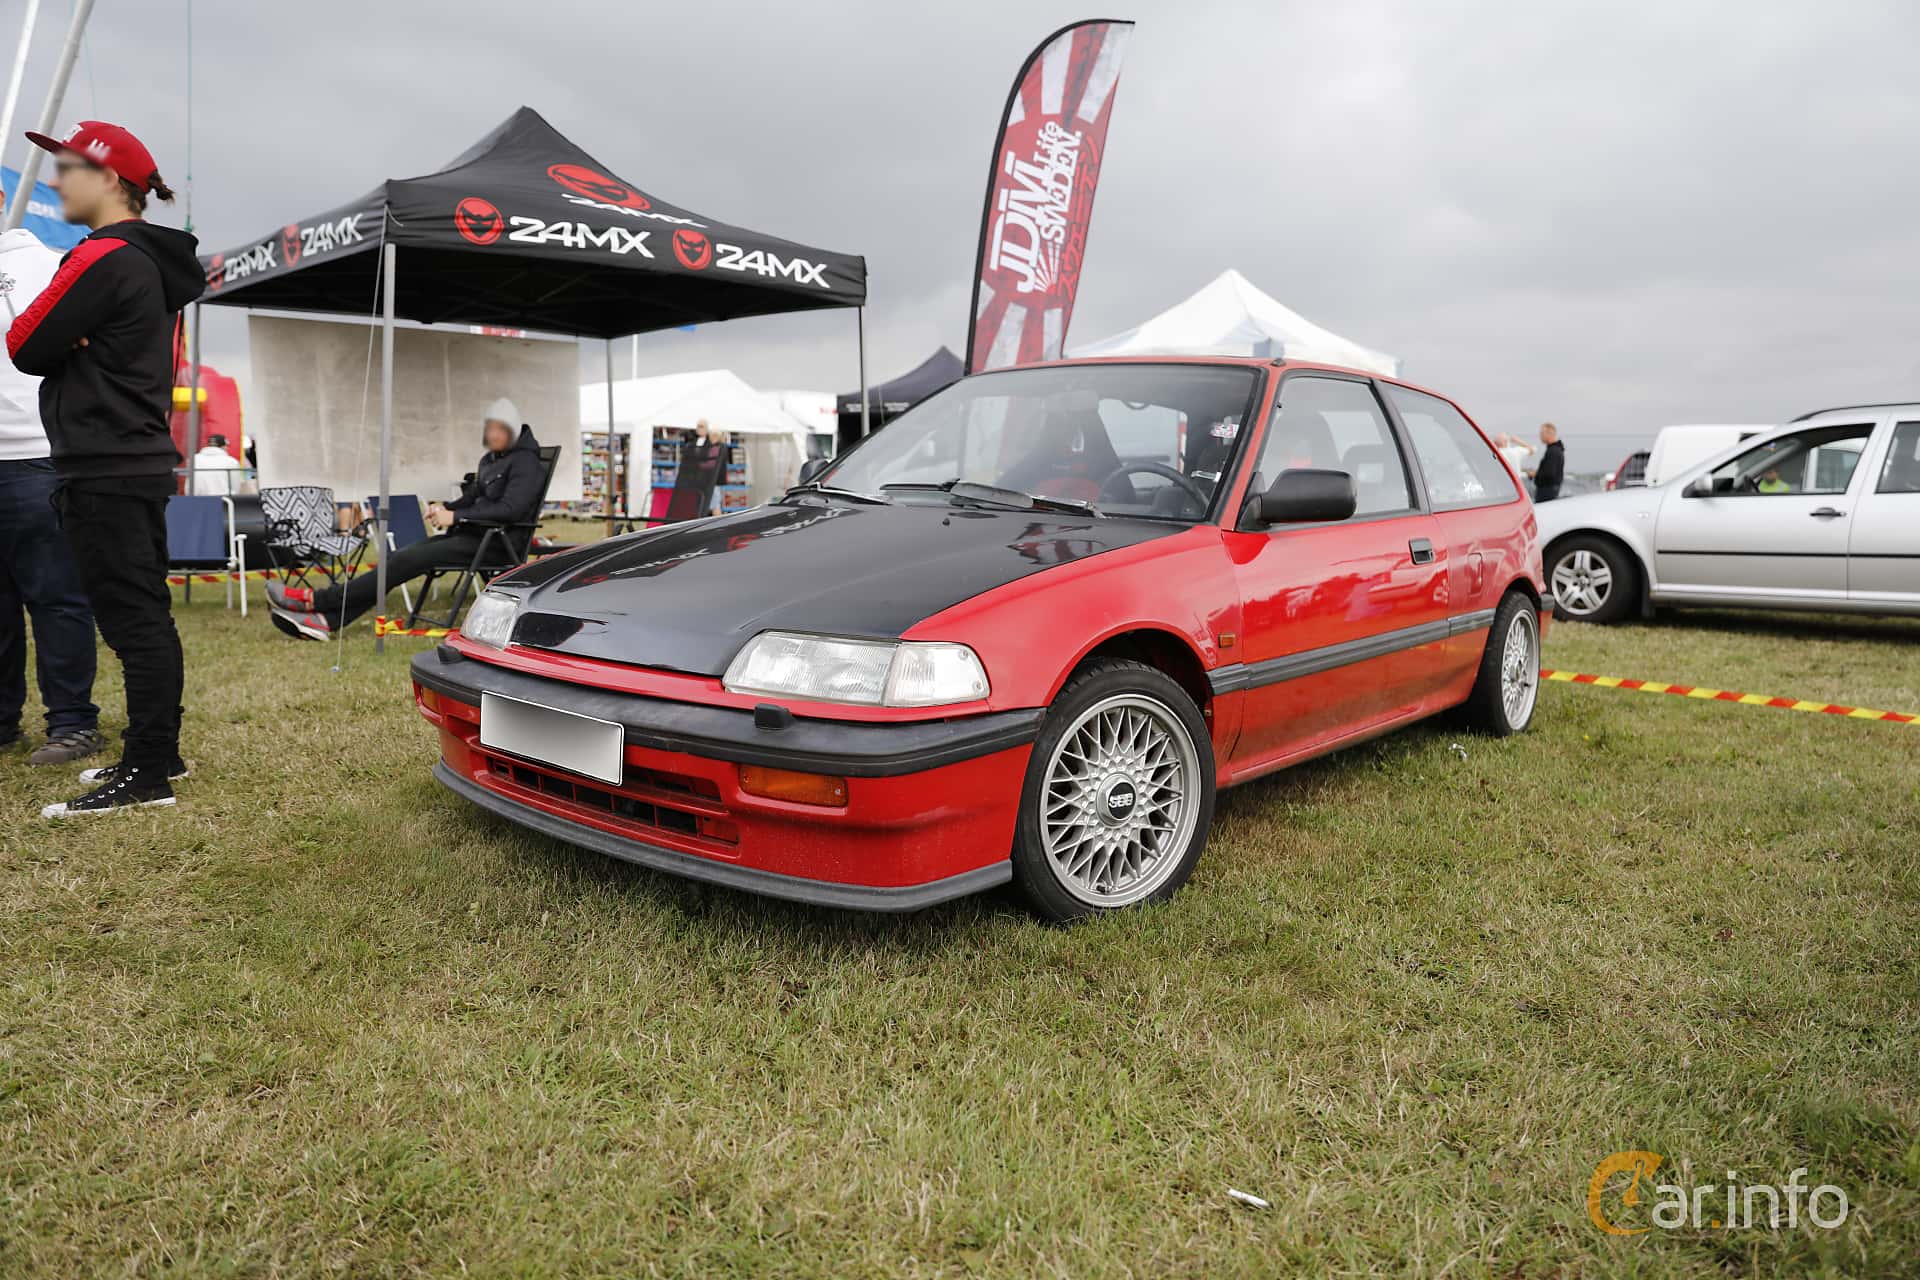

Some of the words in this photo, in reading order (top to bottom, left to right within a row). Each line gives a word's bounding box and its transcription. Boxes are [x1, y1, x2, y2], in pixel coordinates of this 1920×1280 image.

[509, 215, 655, 258] 24MX
[990, 151, 1046, 293] JDM
[716, 243, 831, 288] 24MX
